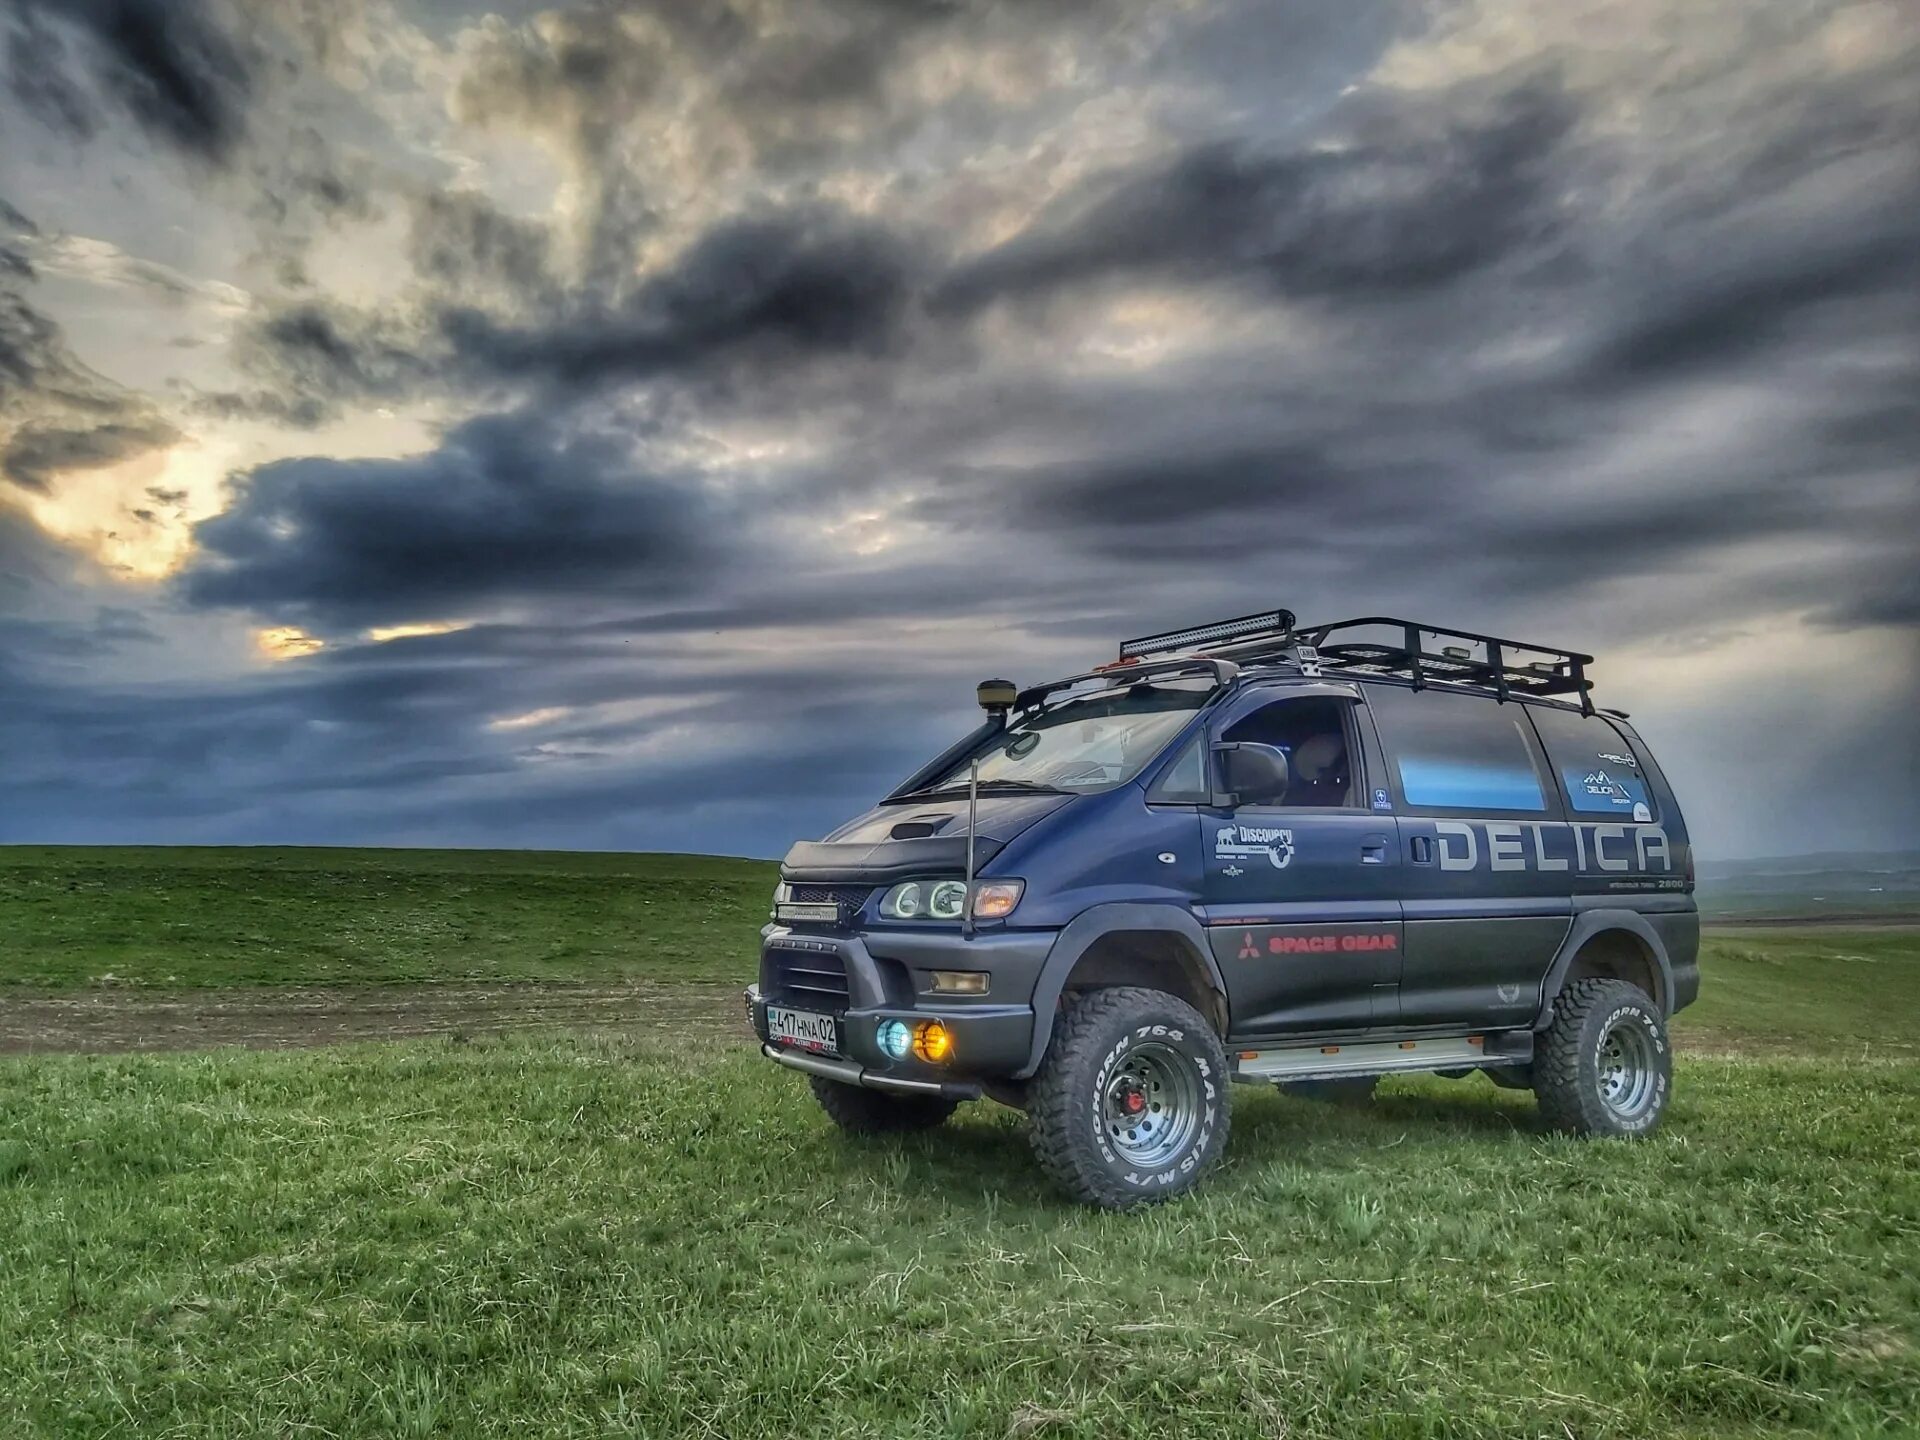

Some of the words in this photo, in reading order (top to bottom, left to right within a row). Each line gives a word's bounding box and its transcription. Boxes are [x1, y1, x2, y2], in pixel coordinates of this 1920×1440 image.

[1586, 785, 1614, 795] DELICA
[1435, 821, 1671, 872] DELICA
[1658, 880, 1684, 888] 2800
[1269, 936, 1337, 954] SPACE
[1341, 934, 1397, 951] GEAR
[1092, 1035, 1129, 1164] BIGHORN
[1136, 1024, 1184, 1042] 764
[1180, 1056, 1216, 1174] MAXXIS
[1124, 1168, 1176, 1187] M/T
